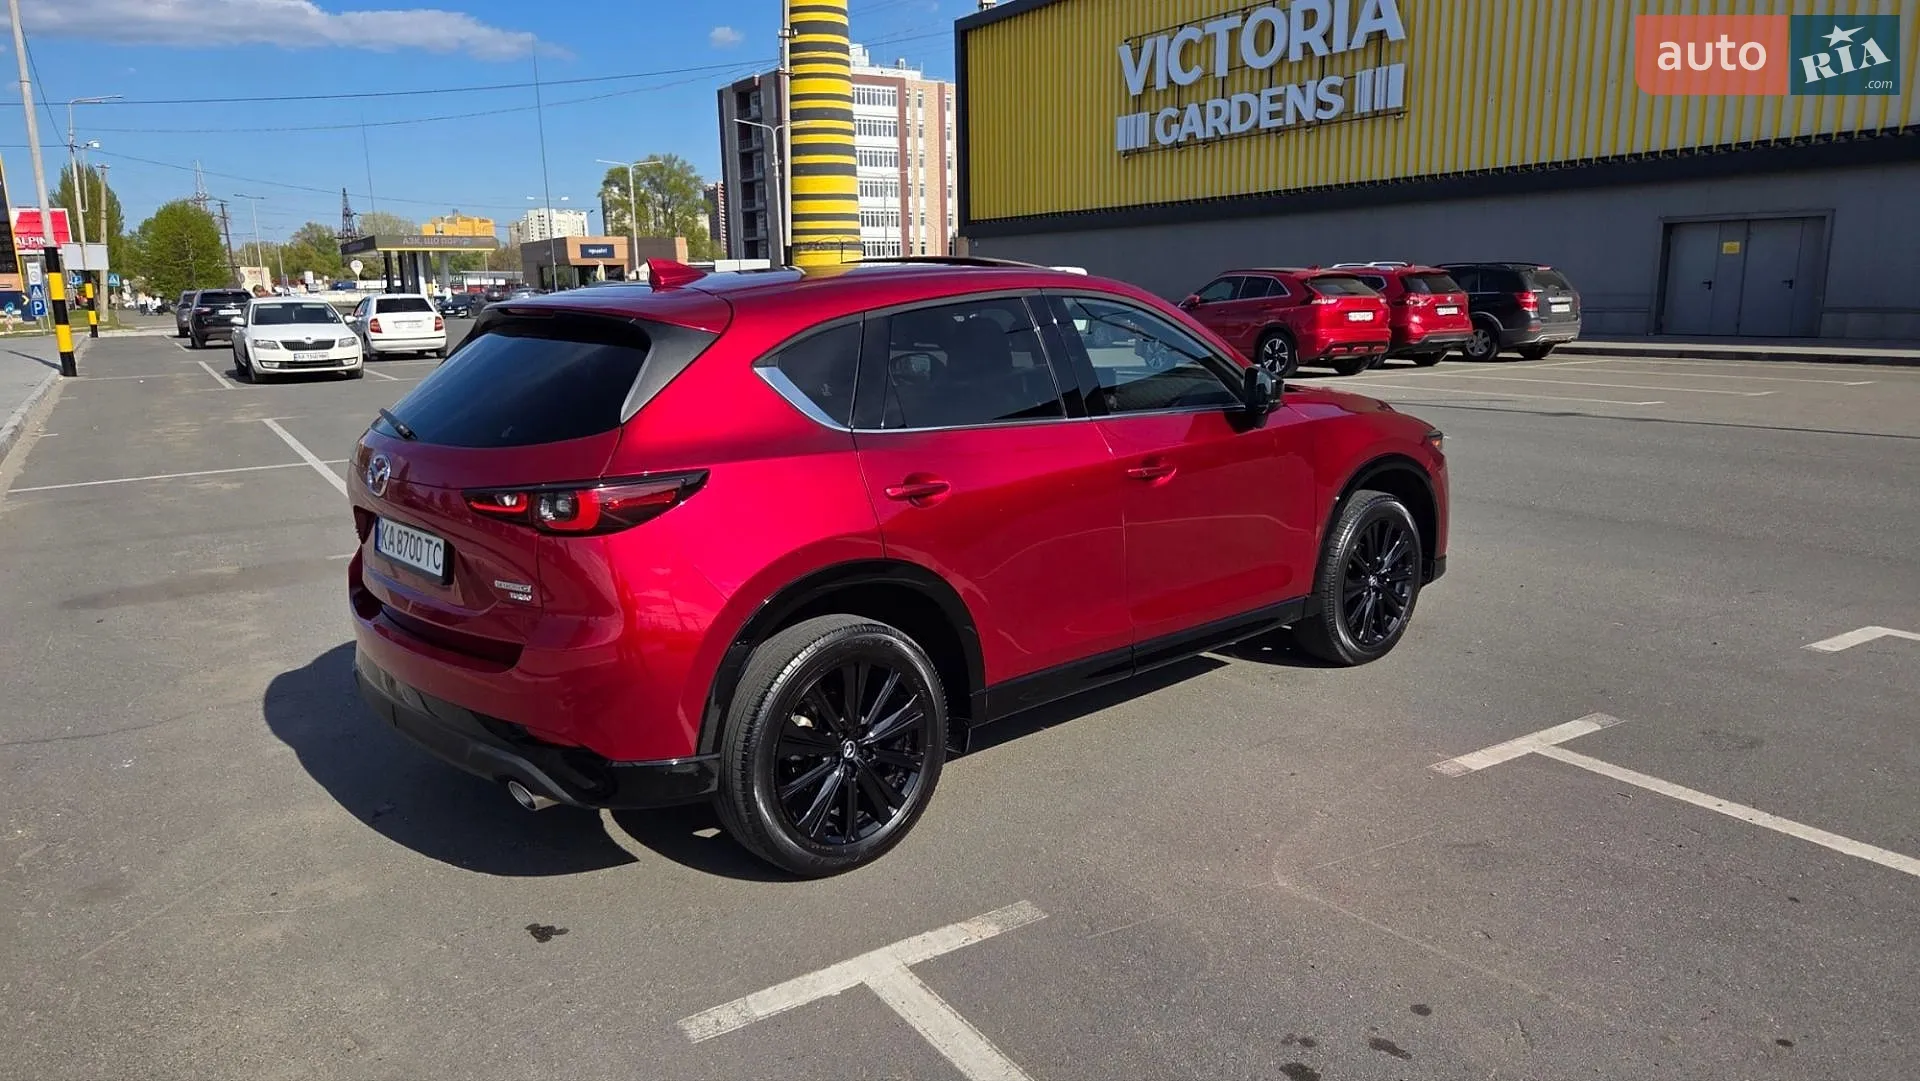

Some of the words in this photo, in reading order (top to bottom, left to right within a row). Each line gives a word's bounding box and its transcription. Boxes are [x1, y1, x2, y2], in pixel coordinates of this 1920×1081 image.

[1118, 0, 1406, 96] VICTORIA
[1154, 75, 1345, 145] GARDENS
[382, 522, 395, 552] KA
[396, 530, 423, 562] 8700
[425, 538, 442, 570] TC
